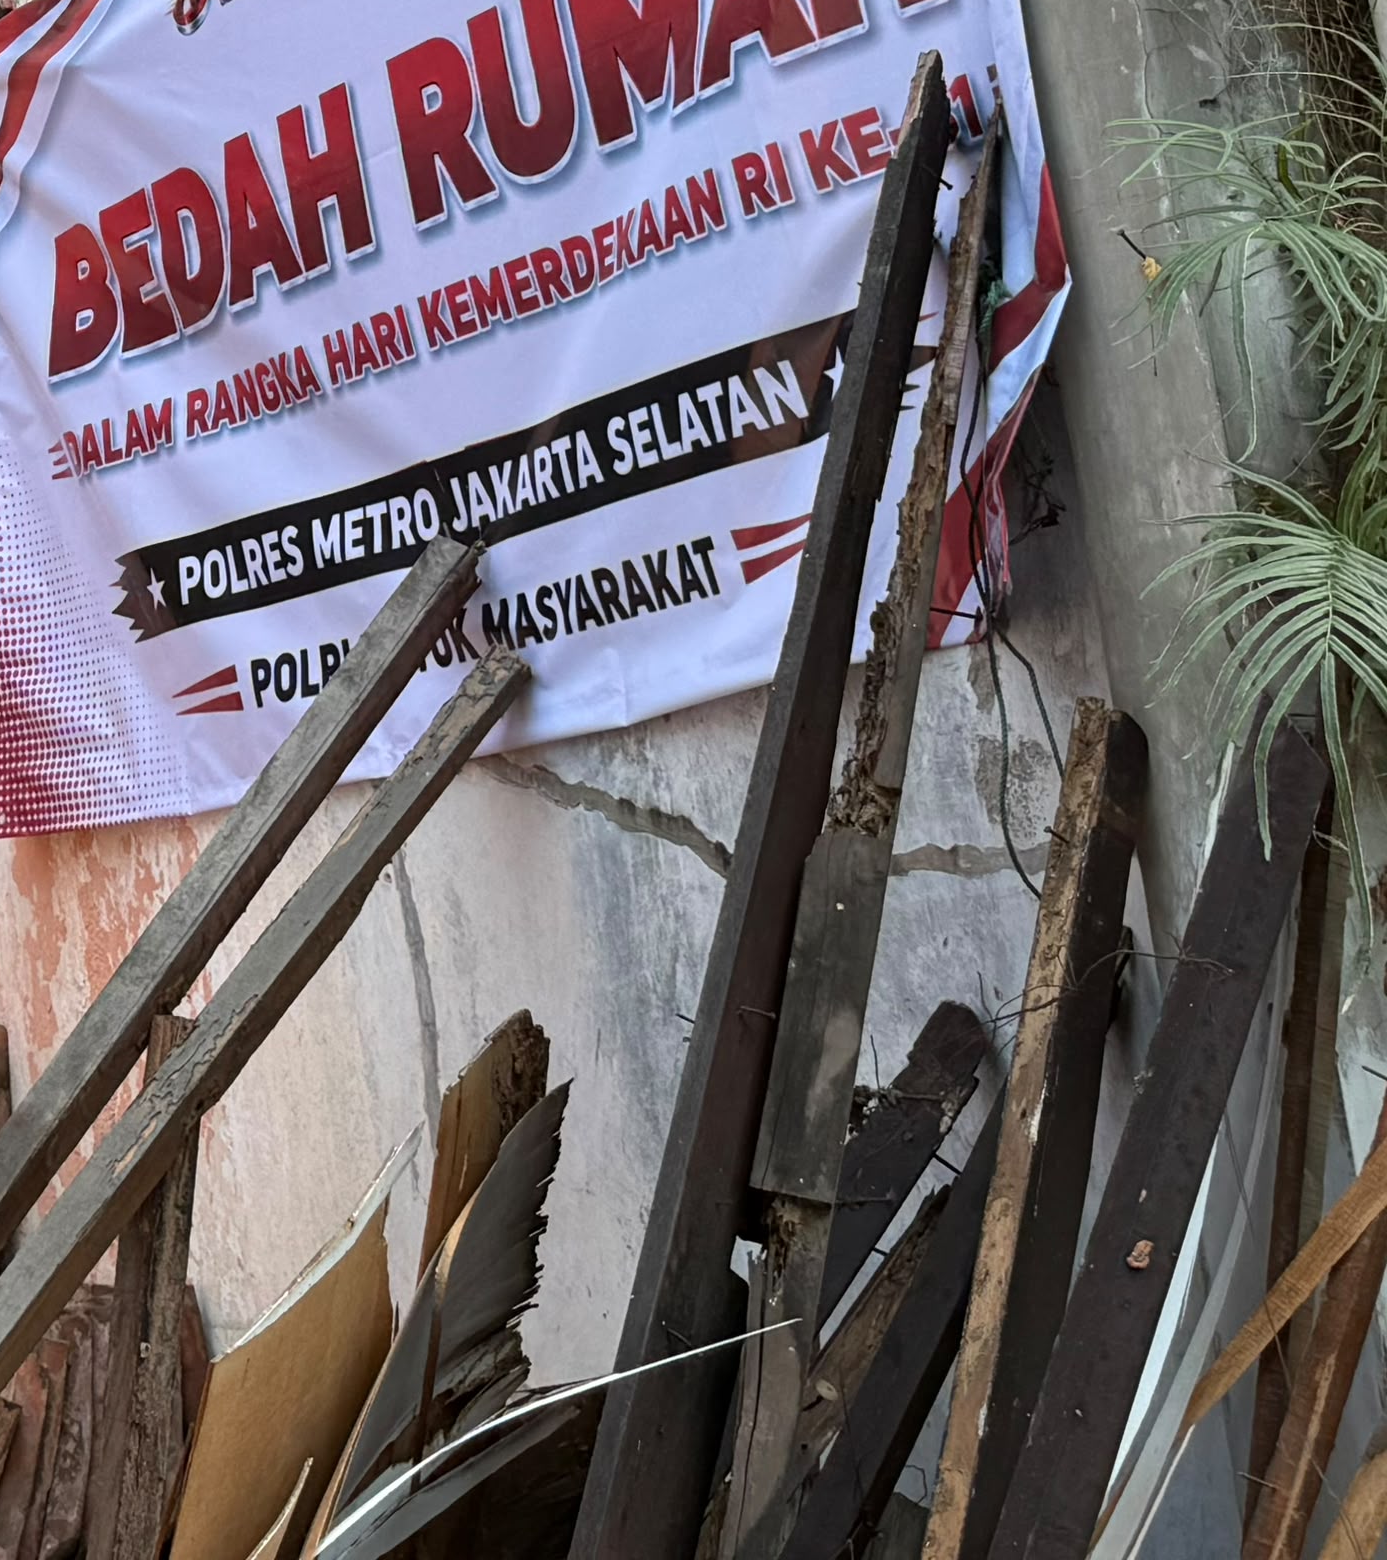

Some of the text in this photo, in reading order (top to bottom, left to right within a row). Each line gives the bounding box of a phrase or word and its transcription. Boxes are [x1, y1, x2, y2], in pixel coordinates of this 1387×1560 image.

[47, 81, 377, 385] BEDAH
[60, 72, 985, 478] DALAM RANGKA HARI KEMERDEKAAN RI KE-1
[178, 359, 809, 606] POLRES METRO JAKARTA SELATAN
[481, 535, 721, 651] MASYARAKAT
